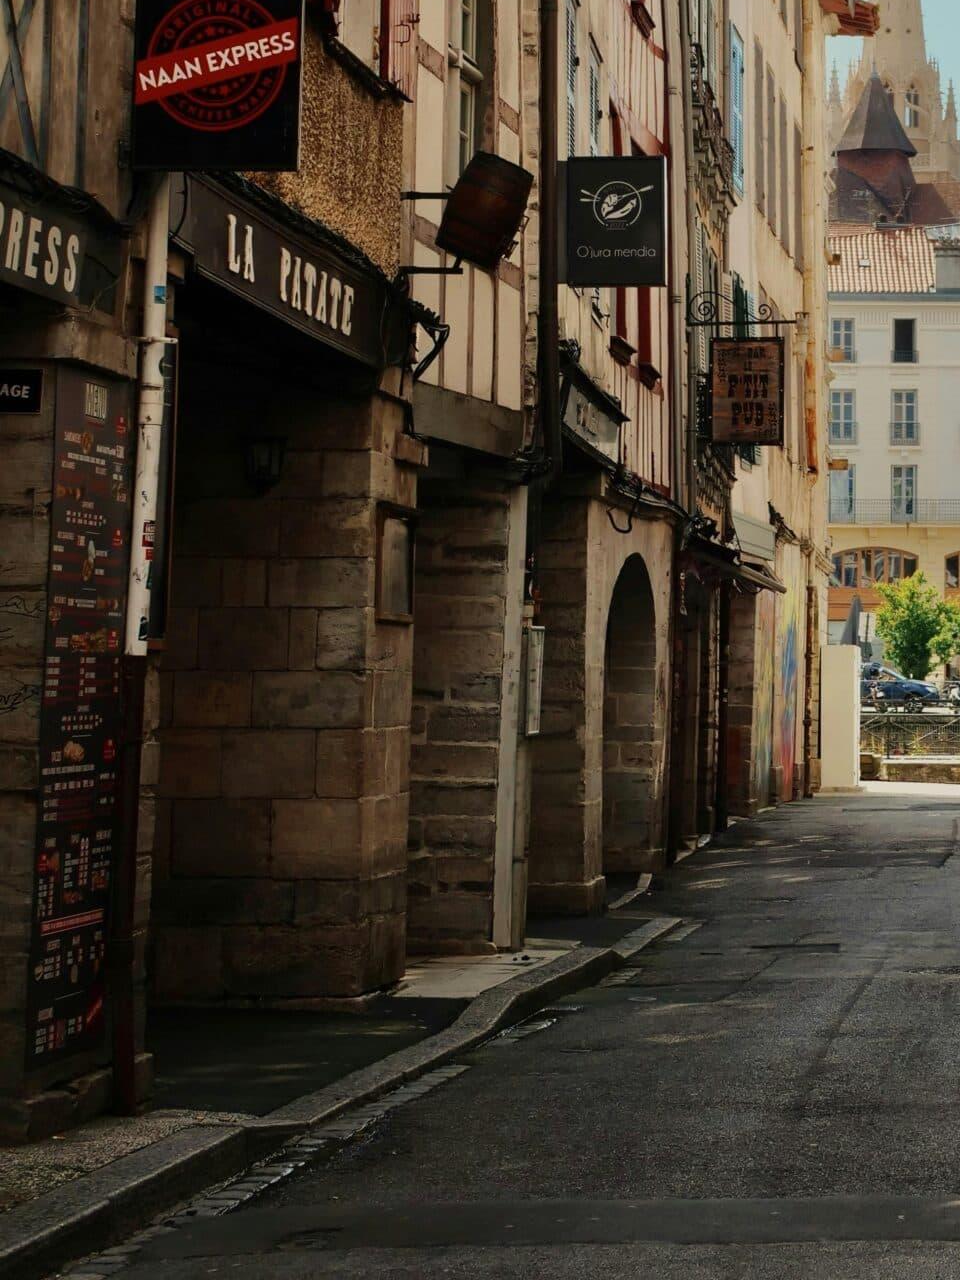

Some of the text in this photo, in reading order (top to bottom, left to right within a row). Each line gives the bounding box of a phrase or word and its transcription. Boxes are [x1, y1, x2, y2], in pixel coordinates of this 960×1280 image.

[164, 0, 250, 39] ORIGINAL
[138, 31, 295, 91] NAAN EXPRESS
[0, 200, 80, 293] RESS
[614, 245, 657, 257] mendia
[227, 213, 354, 336] LA PATATE
[85, 382, 107, 420] MENU
